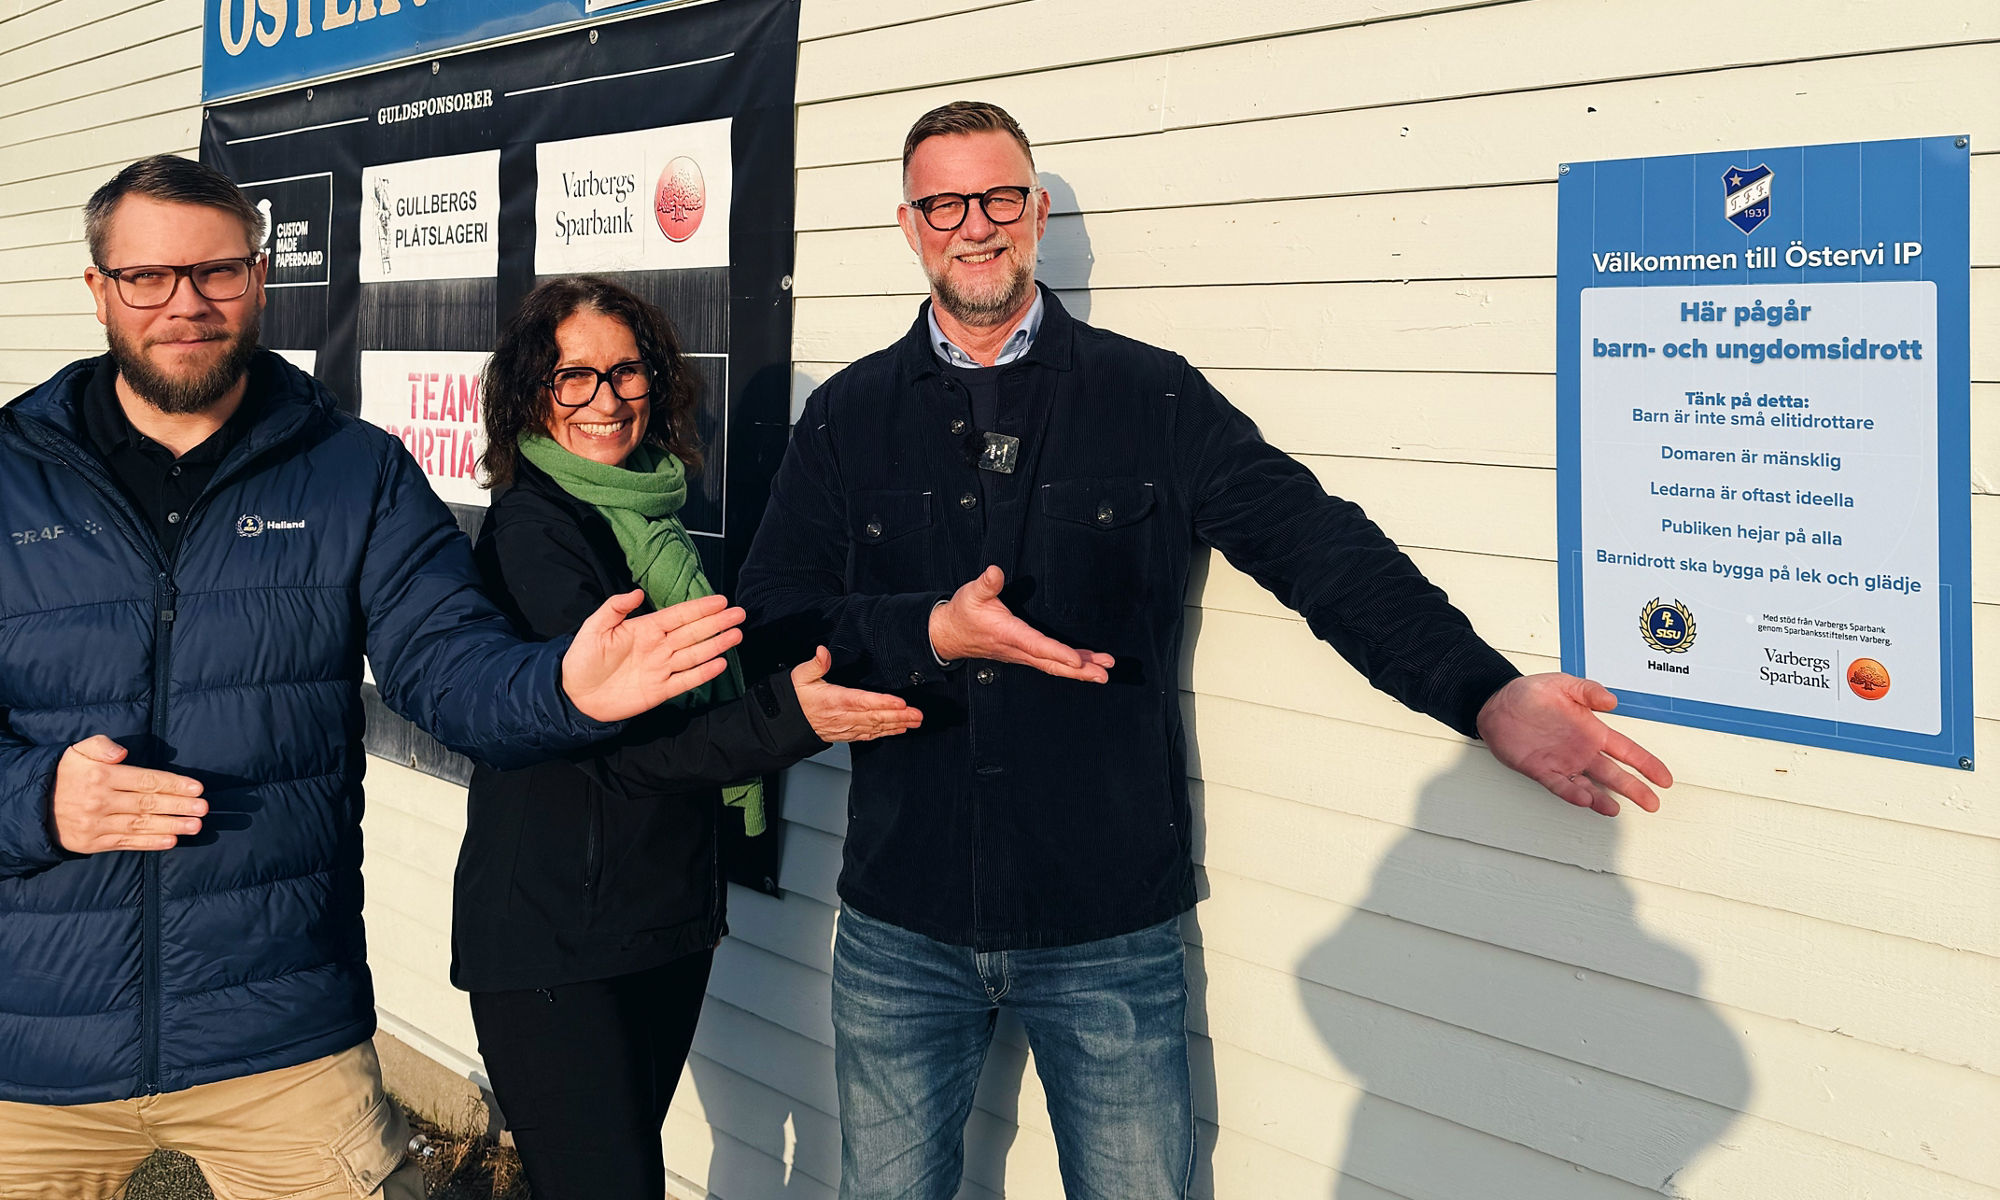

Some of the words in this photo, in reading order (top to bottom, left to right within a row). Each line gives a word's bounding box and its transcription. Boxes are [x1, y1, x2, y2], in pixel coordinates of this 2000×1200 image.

[377, 90, 493, 126] GULDSPONSORER
[562, 170, 636, 202] Varbergs
[396, 190, 478, 218] GULLBERGS
[1744, 208, 1766, 218] 1931
[276, 221, 308, 238] CUSTOM
[394, 220, 488, 249] PLÅTSLAGERI
[555, 206, 634, 244] Sparbank
[276, 238, 298, 252] MADE
[1593, 249, 1737, 273] Välkommen
[1745, 247, 1777, 269] till
[1785, 241, 1885, 268] Östervi
[1894, 241, 1922, 265] IP
[276, 251, 323, 267] PAPERBOARD
[1680, 300, 1726, 322] Här
[1734, 300, 1811, 327] pågår
[1593, 338, 1656, 358] barn-
[1663, 340, 1707, 358] och
[1716, 338, 1922, 364] ungdomsidrott
[408, 373, 479, 423] TEAM
[1685, 392, 1725, 407] Tänk
[1731, 393, 1752, 410] på
[1757, 393, 1809, 409] detta:
[1633, 409, 1669, 424] Barn
[1673, 410, 1691, 425] är
[1695, 411, 1726, 425] inte
[1730, 412, 1766, 427] små
[1770, 413, 1874, 430] elitidrottare
[1661, 446, 1736, 464] Domaren
[1741, 448, 1759, 464] är
[1763, 450, 1841, 471] mänsklig
[1650, 482, 1716, 499] Ledarna
[1720, 485, 1738, 500] är
[1742, 486, 1791, 504] oftast
[1796, 490, 1854, 508] ideella
[11, 525, 72, 545] CRAF
[267, 520, 305, 529] Halland
[1661, 518, 1732, 537] Publiken
[1737, 524, 1780, 545] hejar
[1785, 529, 1806, 547] på
[1812, 531, 1842, 546] alla
[1597, 550, 1675, 569] Barnidrott
[1679, 557, 1707, 573] ska
[1713, 560, 1763, 581] bygga
[1770, 565, 1790, 581] på
[1795, 567, 1821, 584] lek
[1826, 571, 1859, 587] och
[1865, 575, 1922, 594] glädje
[1656, 629, 1680, 640] SISU
[1758, 624, 1783, 633] genom
[1784, 627, 1858, 641] Sparbanksstiftelsen
[1860, 635, 1892, 646] Varberg.
[1763, 614, 1779, 622] Med
[1780, 616, 1796, 624] stöd
[1798, 617, 1813, 626] från
[1814, 620, 1848, 630] Varbergs
[1850, 623, 1886, 633] Sparbank
[1648, 660, 1689, 674] Halland
[1764, 648, 1830, 672] Varbergs
[1760, 666, 1830, 689] Sparbank
